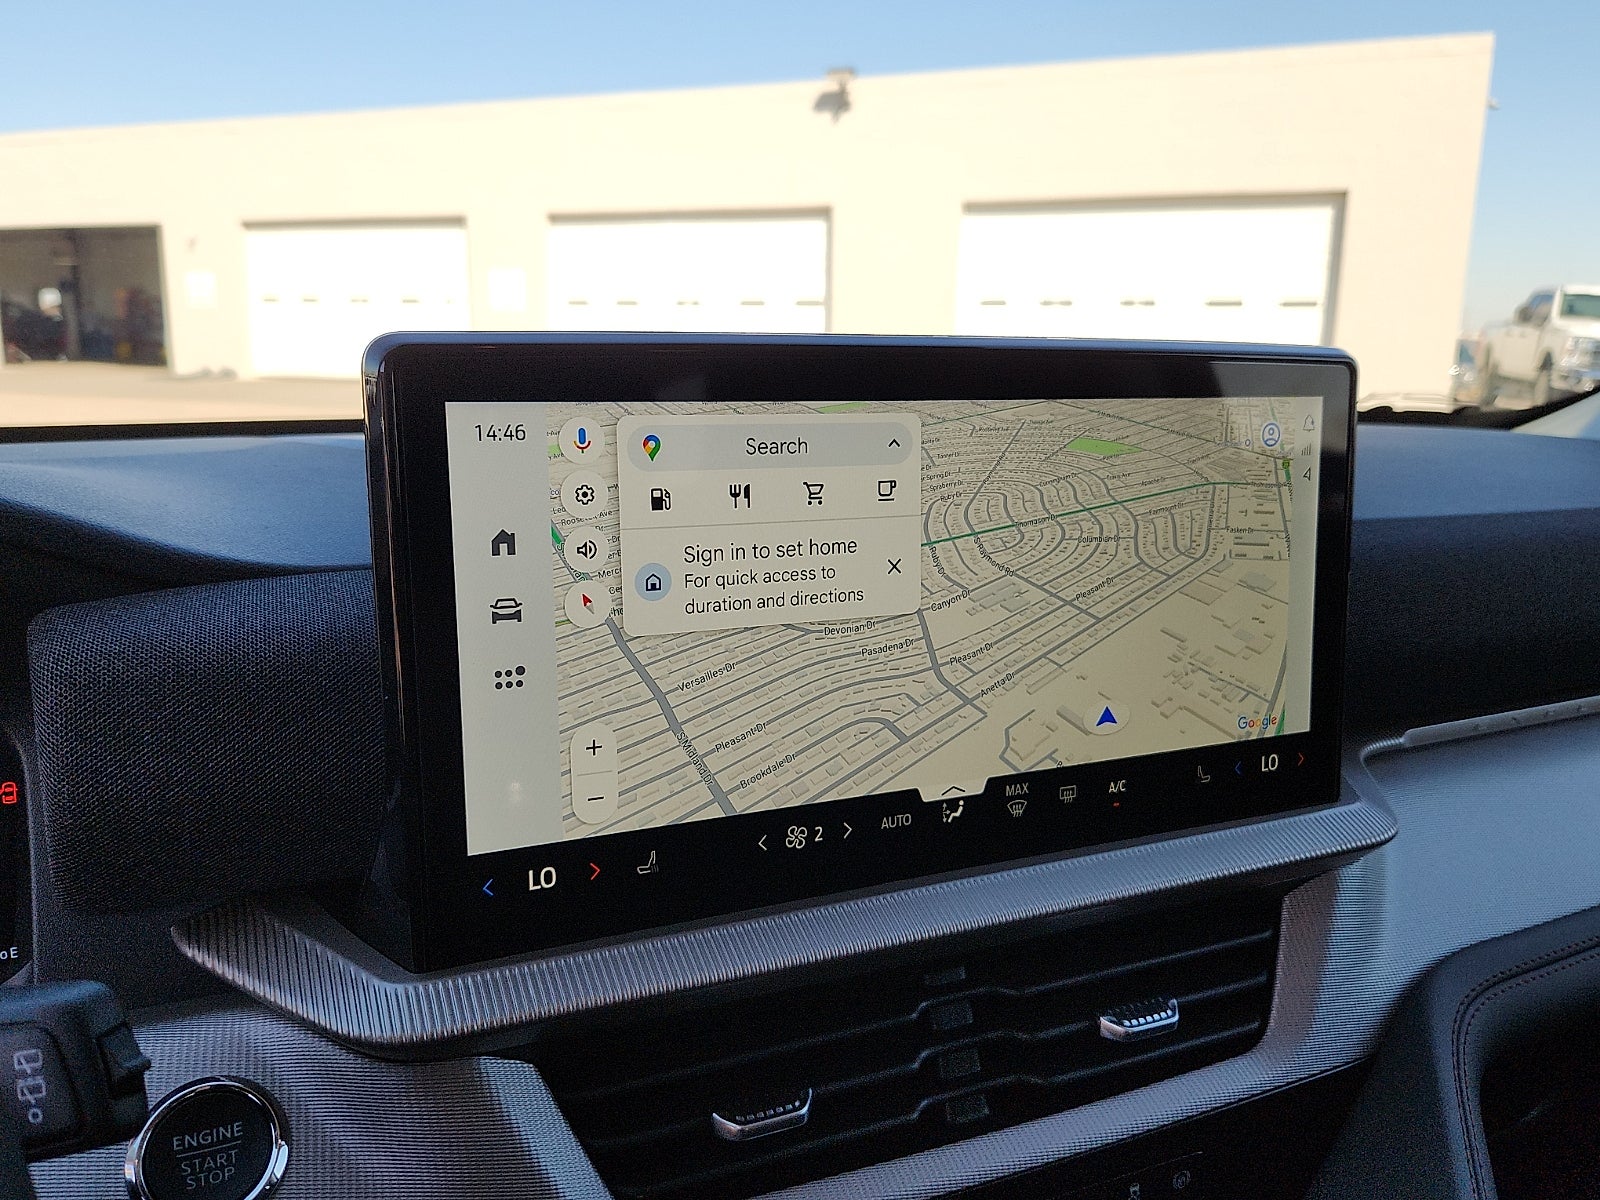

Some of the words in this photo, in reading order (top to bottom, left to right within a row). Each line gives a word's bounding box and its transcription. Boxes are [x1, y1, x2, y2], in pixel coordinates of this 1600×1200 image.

[474, 424, 526, 441] 14:46
[745, 436, 809, 456] Search
[930, 482, 957, 491] Spraberry
[940, 493, 956, 501] Ruby
[1015, 516, 1050, 527] Thomason
[684, 544, 724, 567] Sign
[730, 543, 746, 561] in
[752, 543, 770, 559] to
[776, 540, 804, 558] set
[809, 538, 858, 556] home
[929, 546, 940, 568] Ruby
[937, 566, 946, 577] Dr
[977, 544, 1004, 572] Raymond
[1004, 566, 1014, 577] Rd
[684, 573, 711, 588] For
[715, 569, 759, 590] quick
[763, 569, 817, 584] access
[821, 566, 836, 580] to
[1075, 581, 1105, 600] Pleasant
[1105, 576, 1115, 587] Dr
[685, 598, 752, 615] duration
[757, 592, 785, 609] and
[790, 588, 865, 606] directions
[930, 594, 961, 612] Canyon
[961, 589, 971, 599] Dr
[824, 623, 864, 636] Devonian
[866, 620, 876, 630] Dr
[861, 642, 903, 656] Pasadena
[904, 638, 915, 648] Dr
[949, 647, 984, 665] Pleasant
[984, 642, 994, 653] Dr
[678, 667, 724, 692] Versailles
[724, 663, 736, 674] Dr
[979, 678, 1006, 697] Anetta
[1006, 671, 1016, 683] Dr
[1237, 714, 1278, 730] Google
[677, 731, 686, 741] S
[715, 728, 755, 753] Pleasant
[755, 721, 767, 733] Dr
[681, 736, 708, 775] Midland
[1261, 753, 1279, 772] LO
[703, 773, 713, 786] Dr
[740, 760, 784, 789] Brookdale
[785, 752, 796, 764] Dr
[1005, 782, 1029, 797] MAX
[1108, 780, 1126, 793] A/C
[881, 814, 912, 830] AUTO
[814, 826, 824, 842] 2
[528, 867, 557, 891] LO
[172, 1121, 244, 1151] ENGINE
[181, 1149, 239, 1176] START
[186, 1166, 235, 1190] STOP
